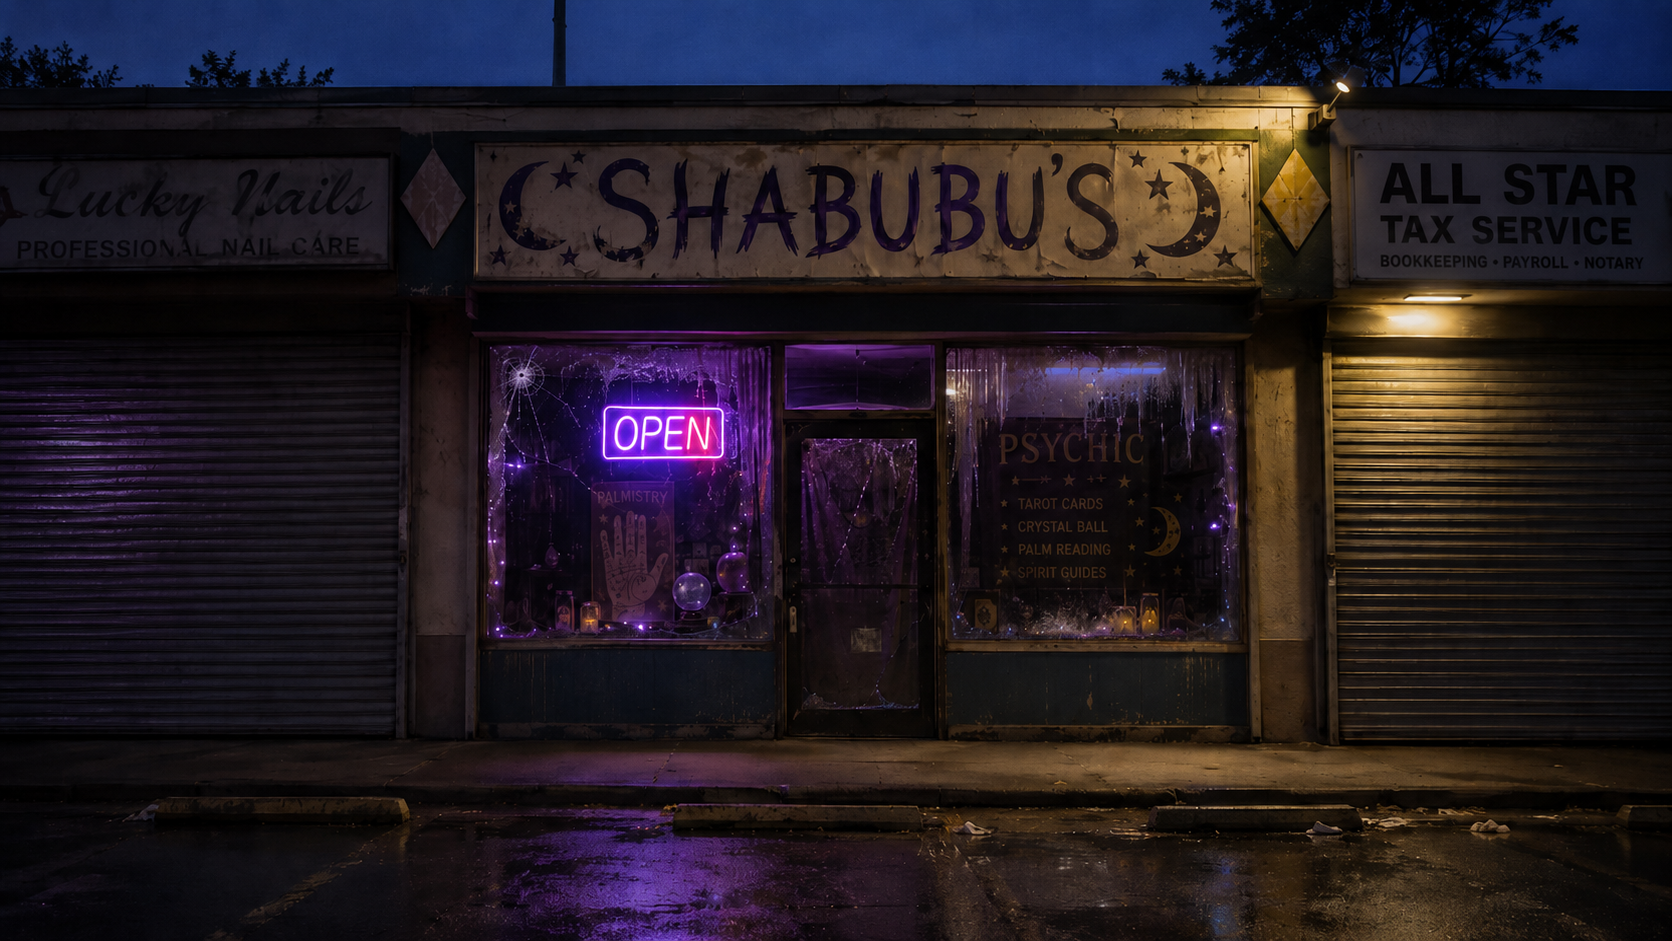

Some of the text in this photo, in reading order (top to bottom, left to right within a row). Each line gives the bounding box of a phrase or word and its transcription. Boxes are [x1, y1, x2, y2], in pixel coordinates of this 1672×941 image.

[1380, 163, 1637, 206] ALL STAR
[34, 163, 373, 237] Lucky Nails
[594, 154, 1118, 261] SHABUBU'S
[1380, 215, 1632, 245] TAX SERVICE
[17, 236, 360, 259] PROFESSIONAL NAIL CARE
[1380, 254, 1644, 269] BOOKKEEPING PAYROLL NOTARY
[613, 415, 711, 451] OPEN
[998, 433, 1145, 465] PSYCHIC
[597, 490, 668, 503] PALMISTRY
[1018, 498, 1104, 510] TAROT CARDS
[1018, 521, 1108, 533] CRYSTAL BALL
[1018, 543, 1111, 556] PALM READING
[1018, 566, 1107, 579] SPIRIT GUIDES
